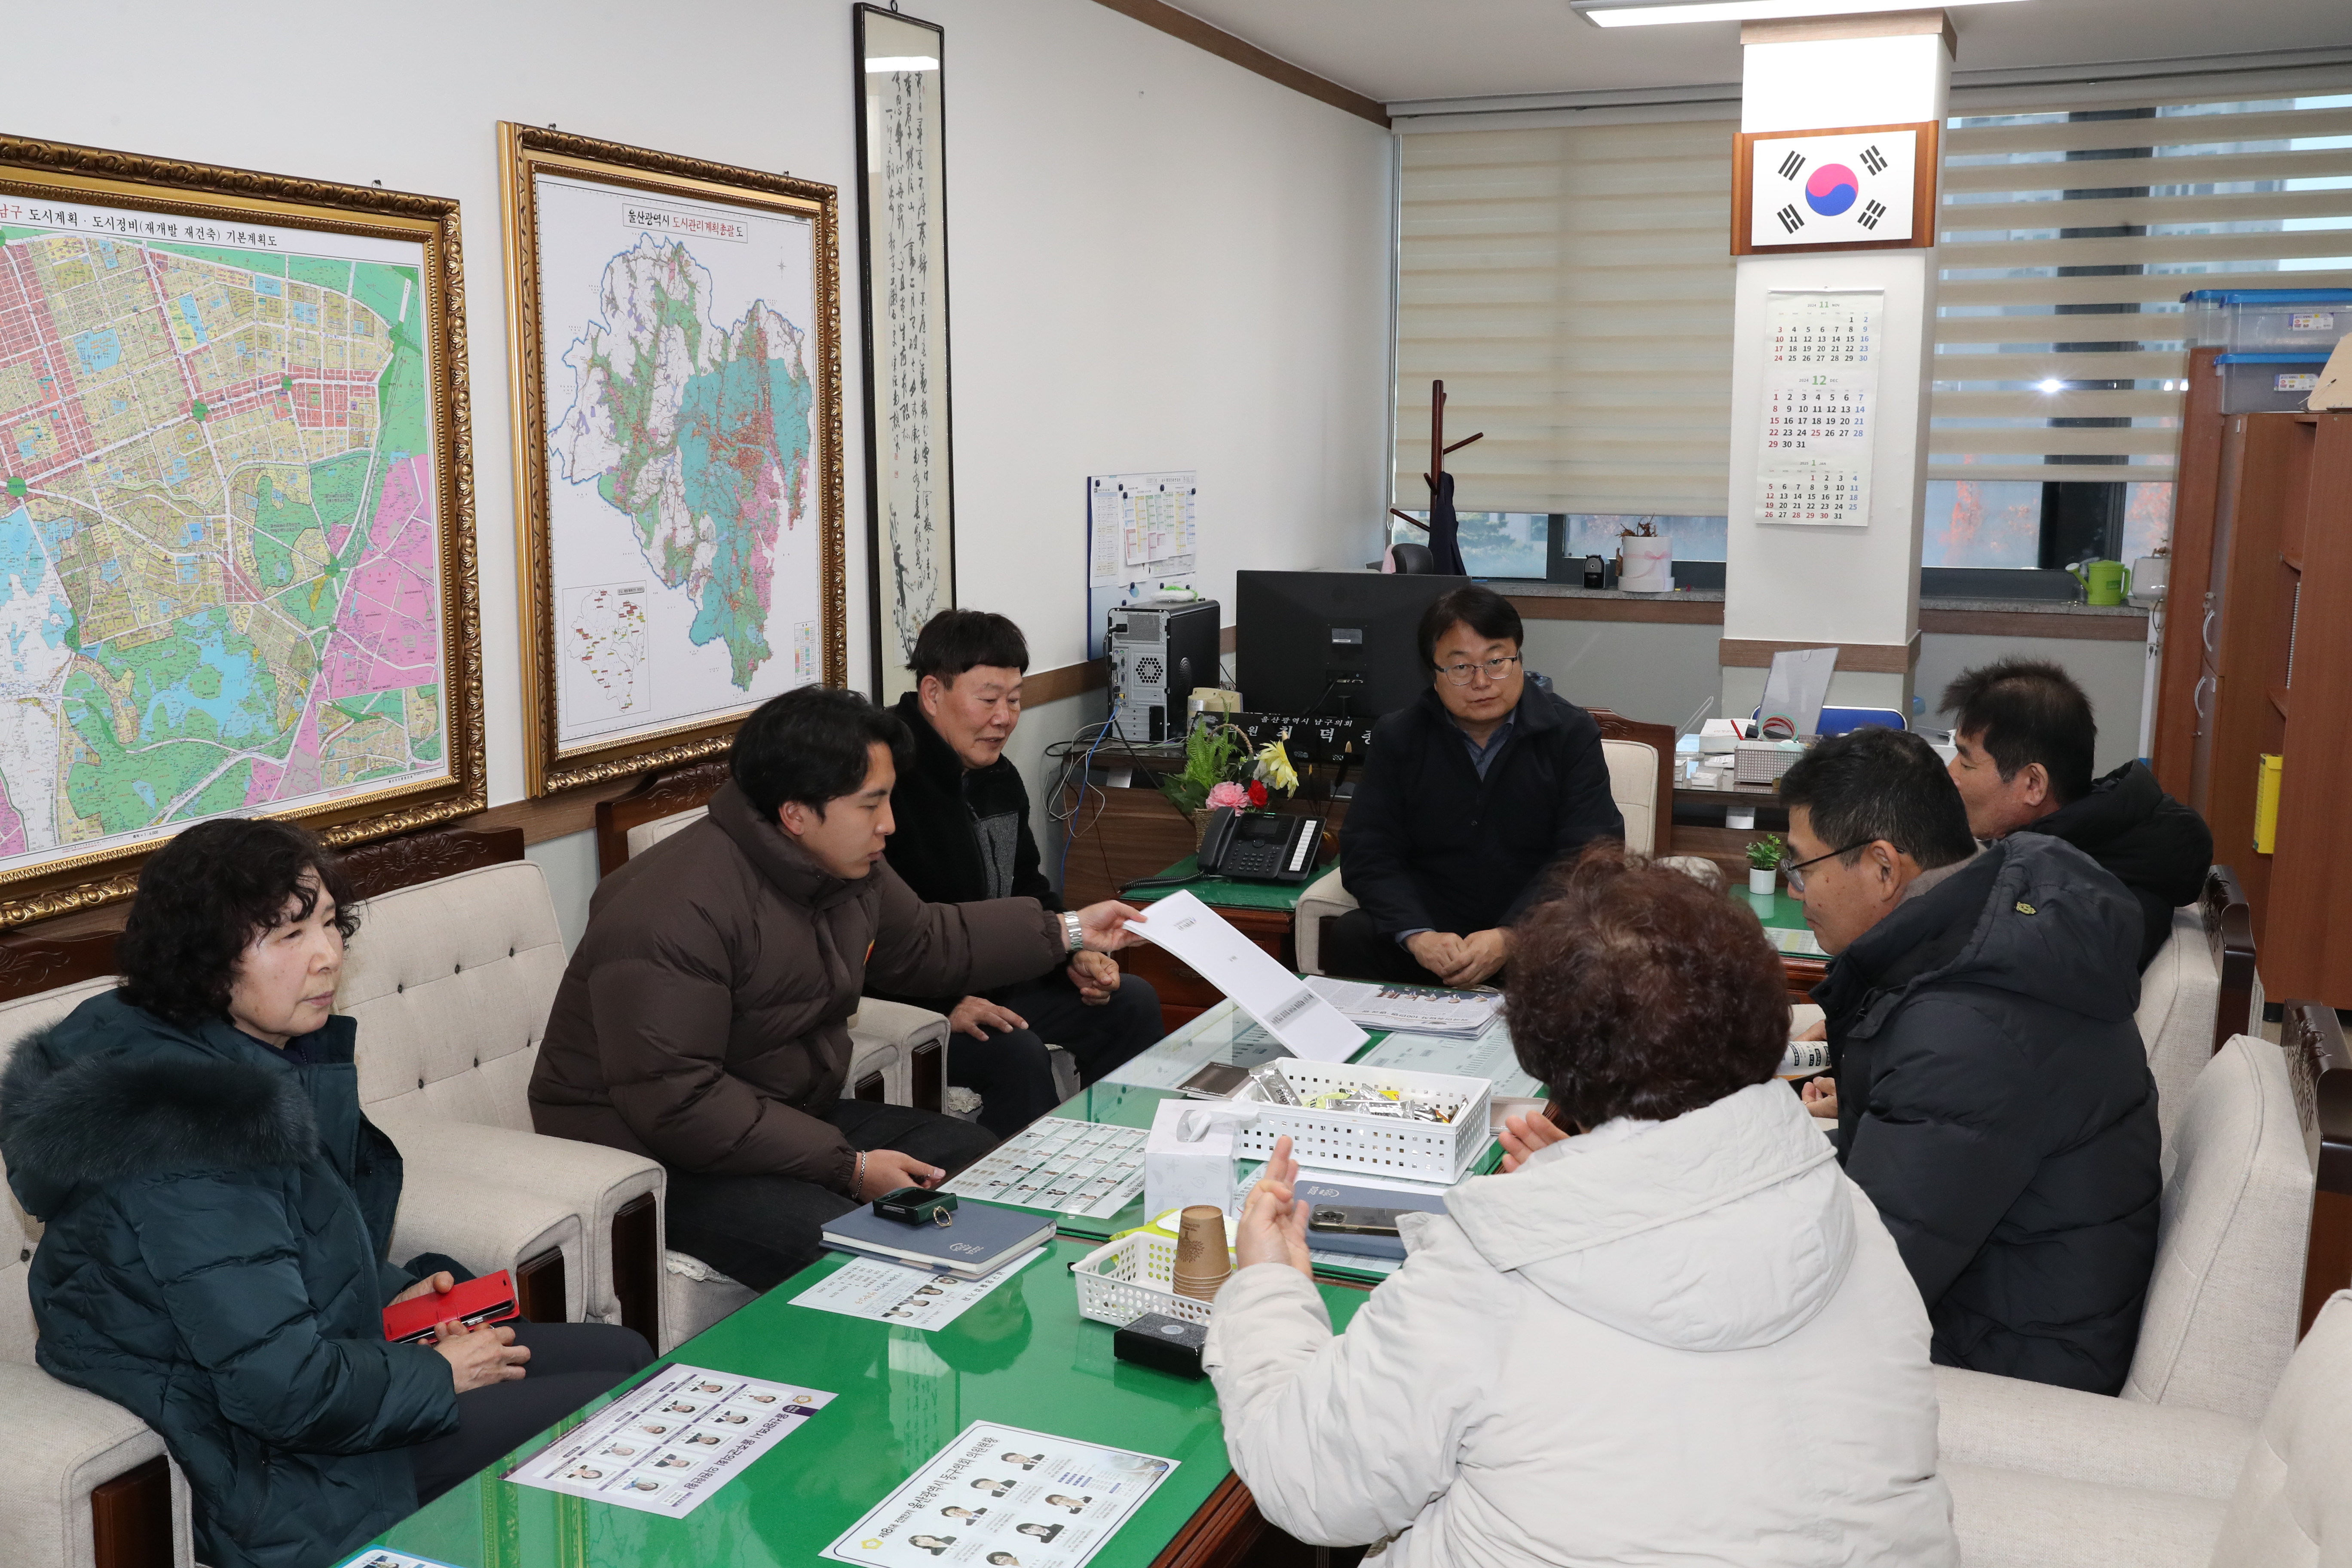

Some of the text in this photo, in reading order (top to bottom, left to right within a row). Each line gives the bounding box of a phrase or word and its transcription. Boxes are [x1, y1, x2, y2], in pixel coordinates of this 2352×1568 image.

[628, 209, 669, 227] 울산광역시
[29, 208, 77, 227] 도시계획
[92, 215, 178, 238] 도시정비(재개발
[184, 227, 220, 242] 재건축)
[227, 230, 277, 247] 기본계획도
[1813, 376, 1826, 385] 12
[1261, 715, 1353, 727] 울산광역시 남구의회
[1308, 1186, 1320, 1195] 2024
[965, 1246, 984, 1254] 2024
[681, 1412, 790, 1490] 울산광역시 울주군의회 의원현황
[874, 1436, 1001, 1538] 제8대 전반기 울산광역시 동구의회 의원현황
